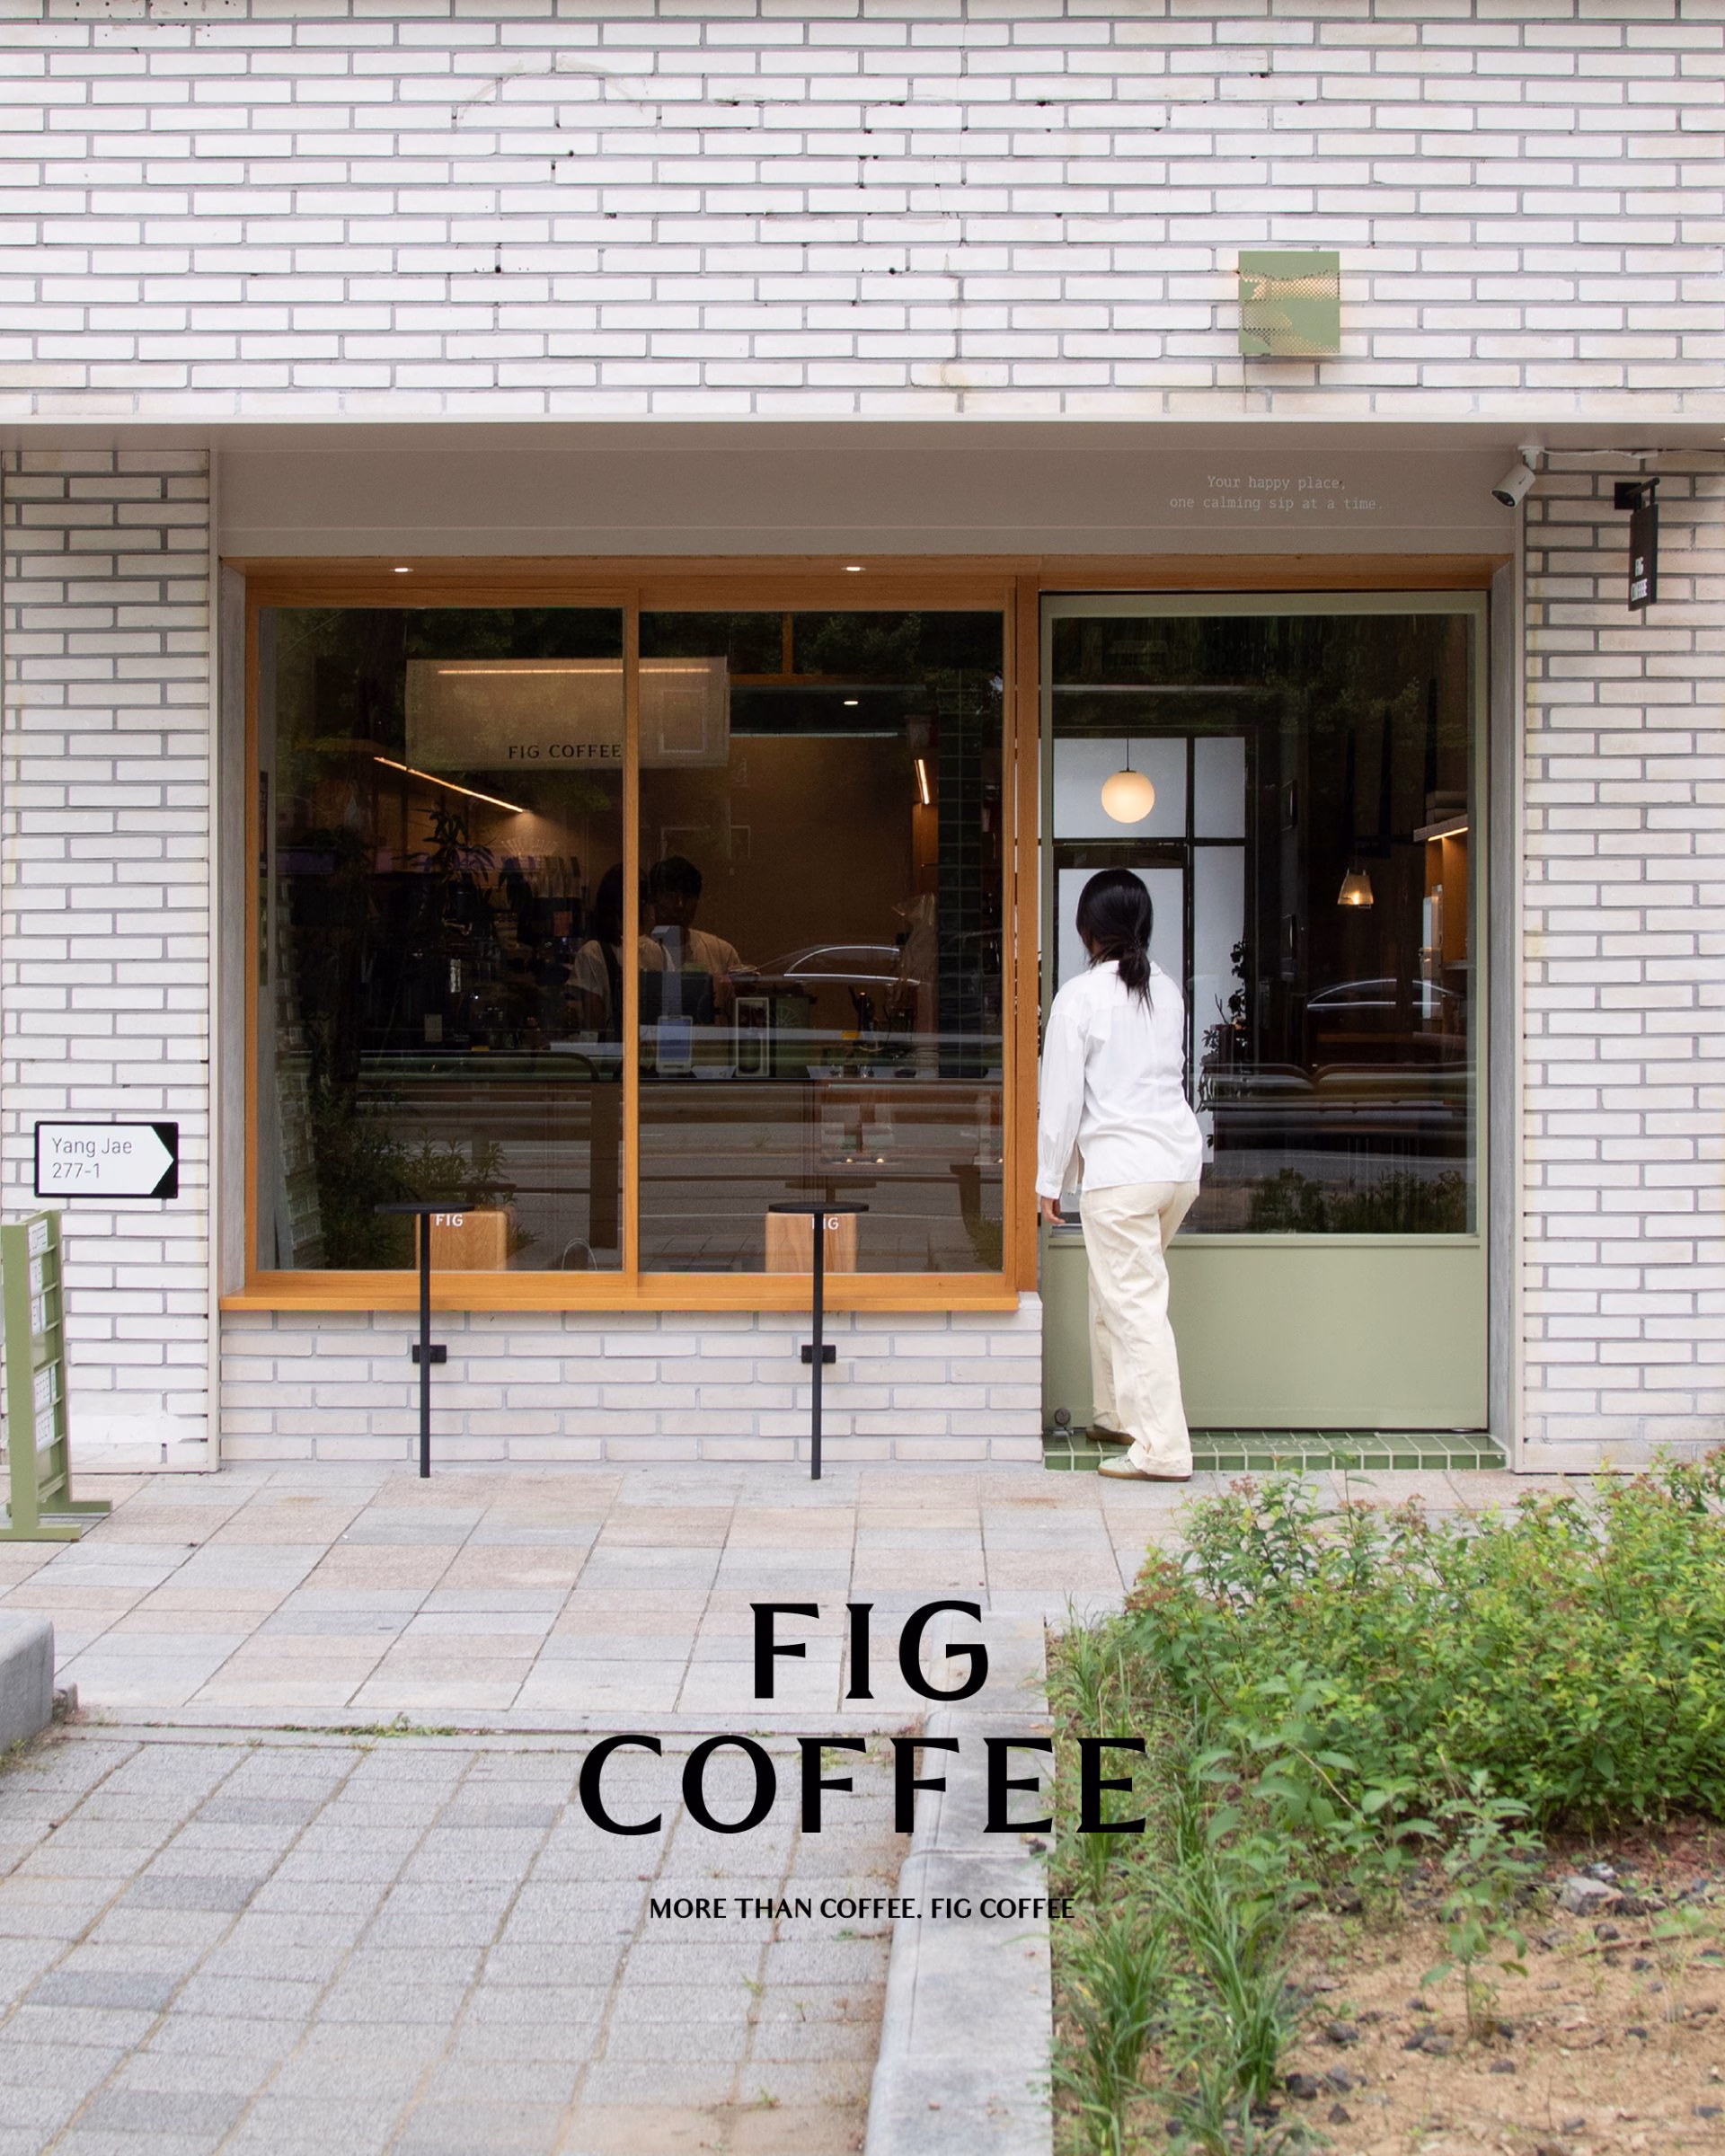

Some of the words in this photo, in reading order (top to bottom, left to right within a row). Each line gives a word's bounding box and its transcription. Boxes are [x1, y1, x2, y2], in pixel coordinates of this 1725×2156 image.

[1208, 475, 1241, 489] Your
[1249, 475, 1290, 490] happy
[1170, 498, 1195, 508] one
[1203, 497, 1261, 511] calming
[1269, 497, 1294, 512] sip
[1302, 498, 1318, 509] at
[1327, 499, 1335, 509] a
[509, 745, 540, 759] FIG
[548, 744, 622, 758] COFFEE
[52, 1137, 96, 1157] Yang
[101, 1137, 132, 1154] Jae
[52, 1162, 100, 1179] 277-1
[435, 1214, 464, 1227] FIG
